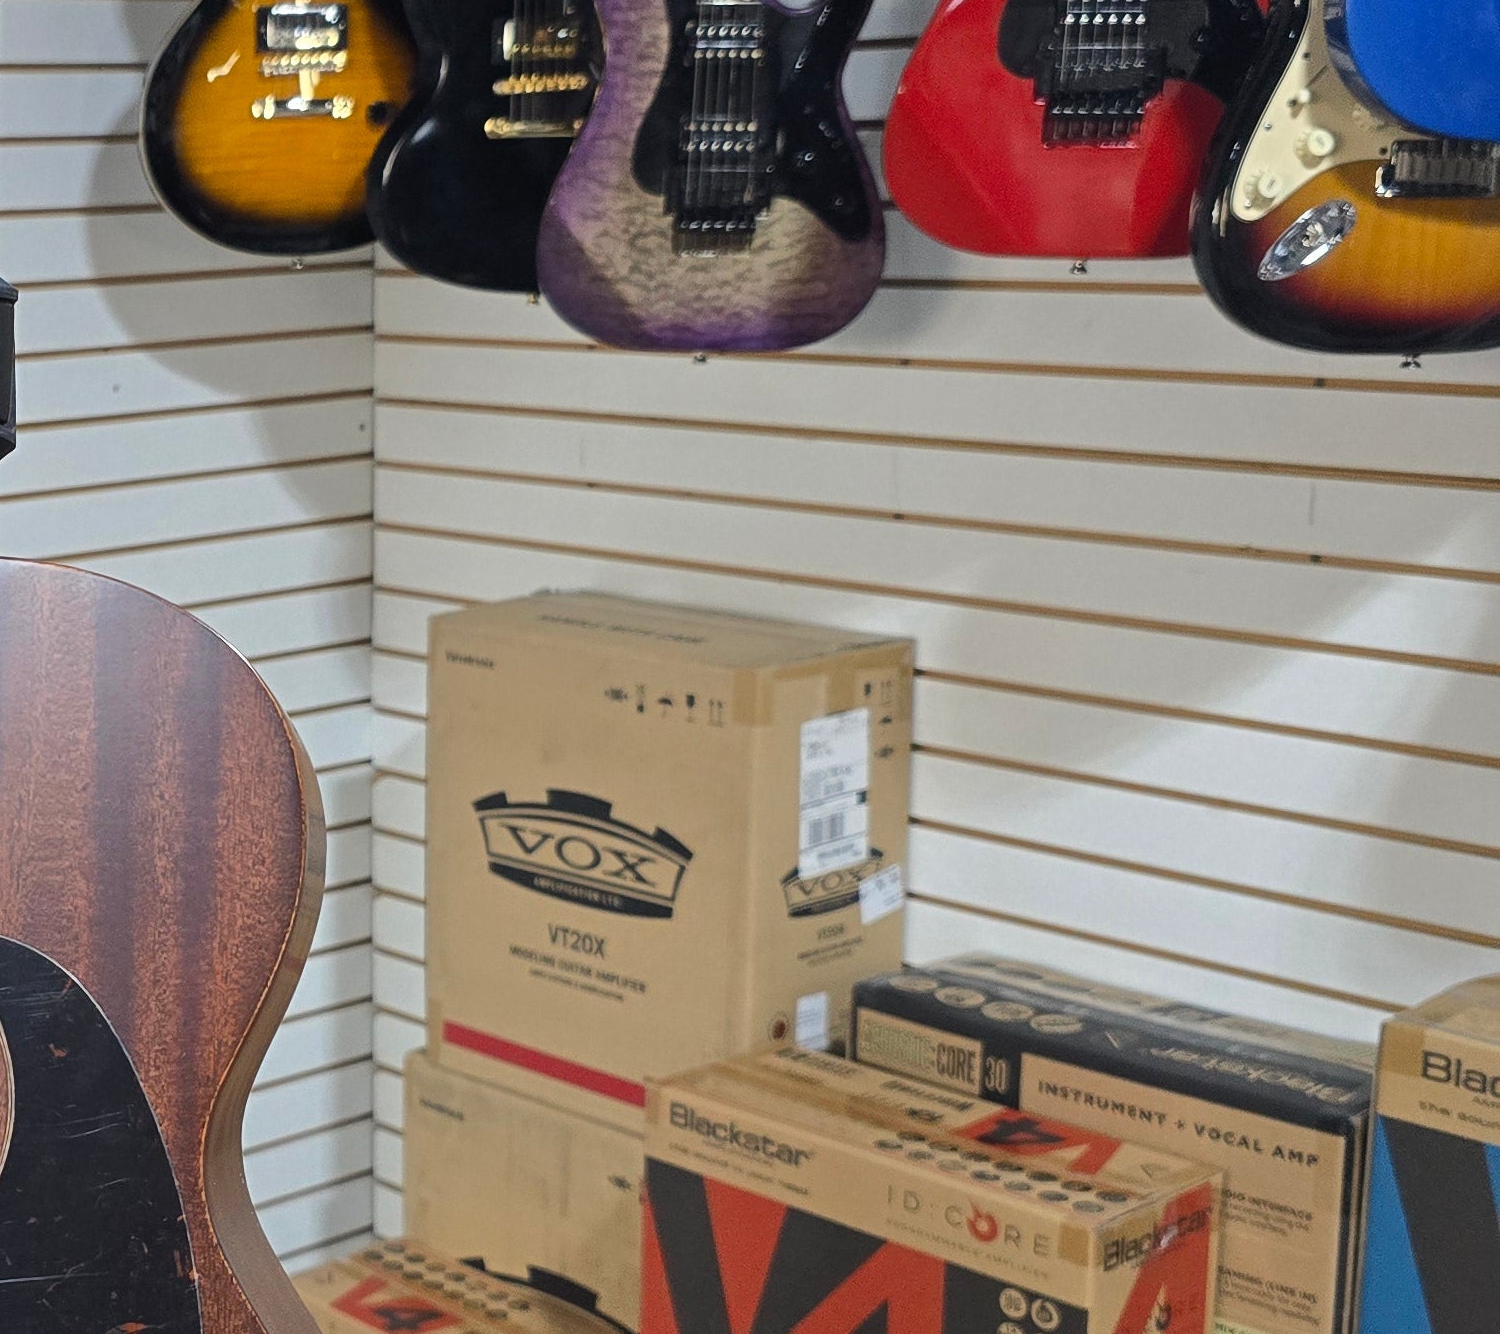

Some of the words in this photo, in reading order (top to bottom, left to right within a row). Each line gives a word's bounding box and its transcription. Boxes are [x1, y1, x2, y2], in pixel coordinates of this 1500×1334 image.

[500, 823, 657, 888] VOX
[547, 922, 606, 959] VT20X
[668, 1099, 812, 1167] Blackstar
[1038, 1080, 1167, 1127] INSTRUMENT
[1194, 1122, 1263, 1153] VOCAL
[1271, 1145, 1320, 1168] AMP
